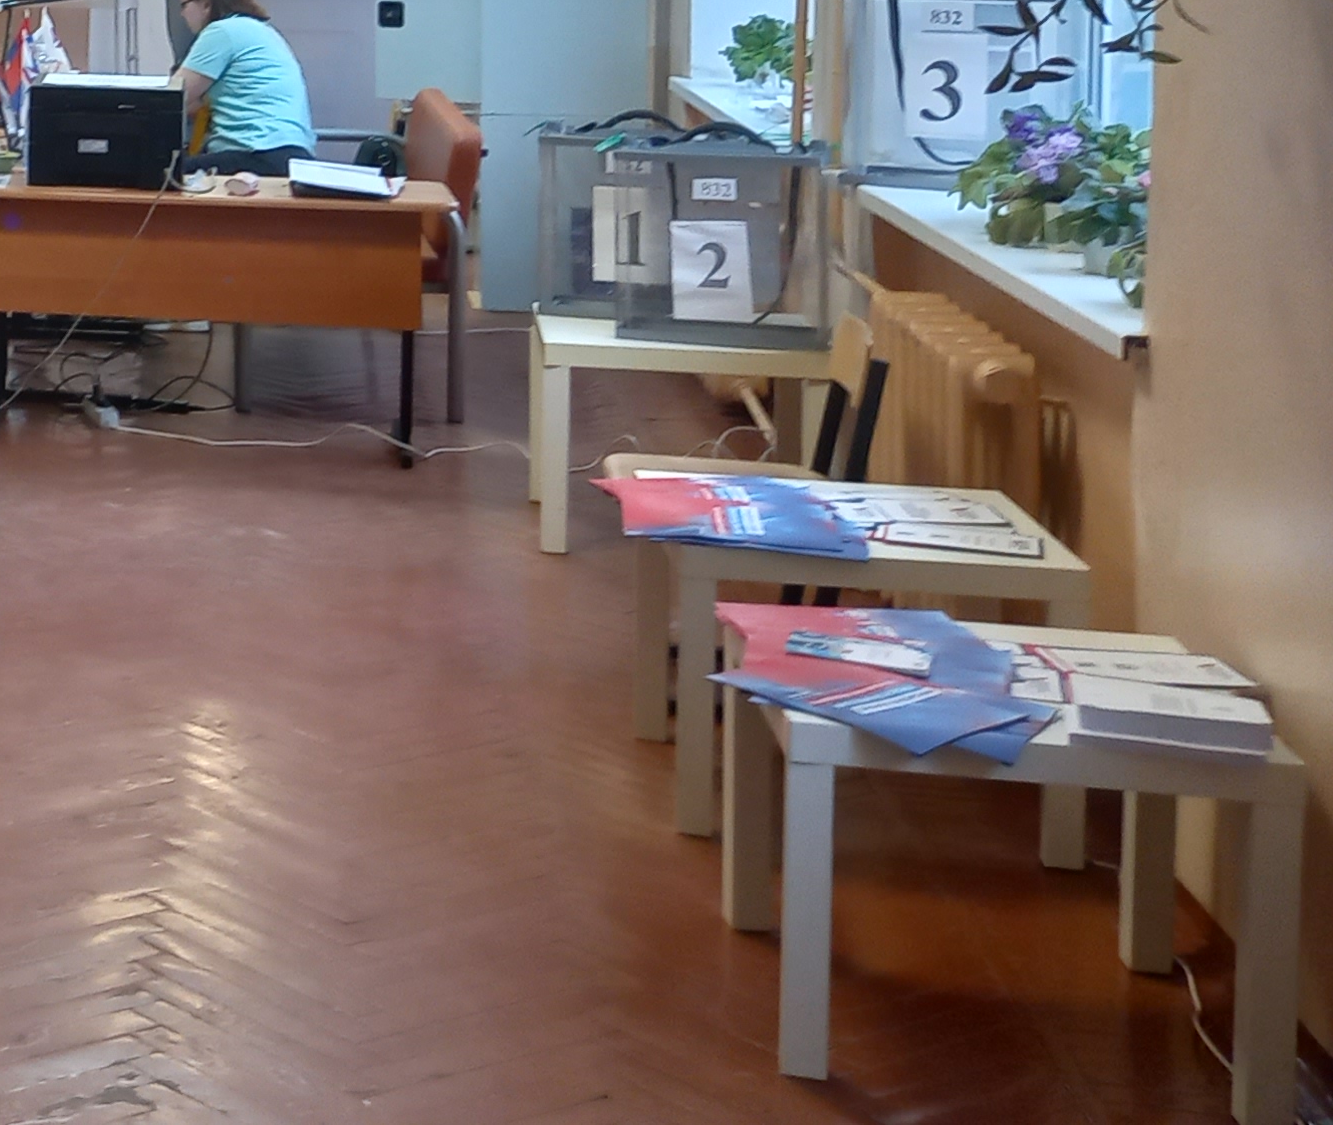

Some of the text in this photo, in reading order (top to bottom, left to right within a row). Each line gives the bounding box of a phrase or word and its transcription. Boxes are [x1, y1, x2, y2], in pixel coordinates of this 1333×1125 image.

[929, 8, 962, 25] 832
[920, 60, 962, 121] 3
[701, 181, 732, 198] 832
[616, 210, 646, 266] 1
[696, 242, 731, 289] 2
